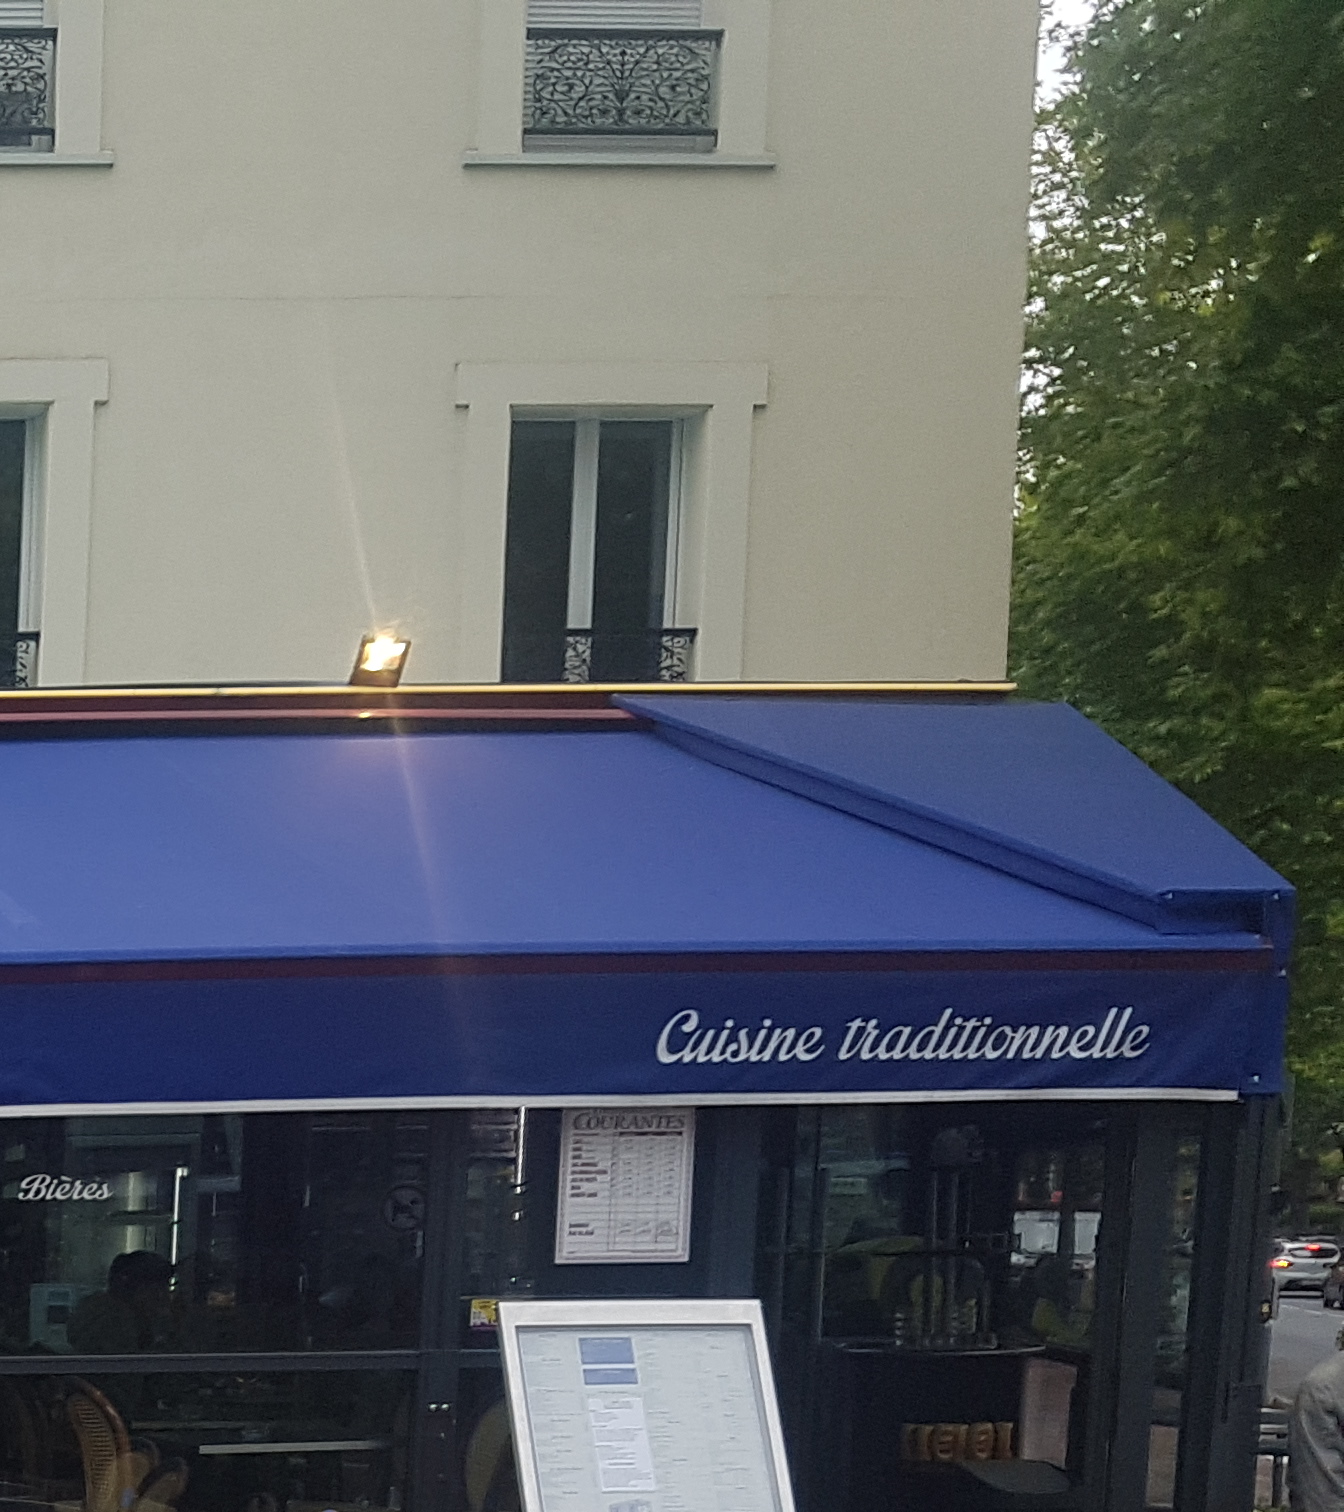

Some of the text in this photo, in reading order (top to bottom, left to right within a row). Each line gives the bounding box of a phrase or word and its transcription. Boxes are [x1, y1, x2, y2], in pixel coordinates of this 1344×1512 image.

[655, 1005, 1152, 1064] Cuisine traditionnelle
[17, 1173, 114, 1200] Bières
